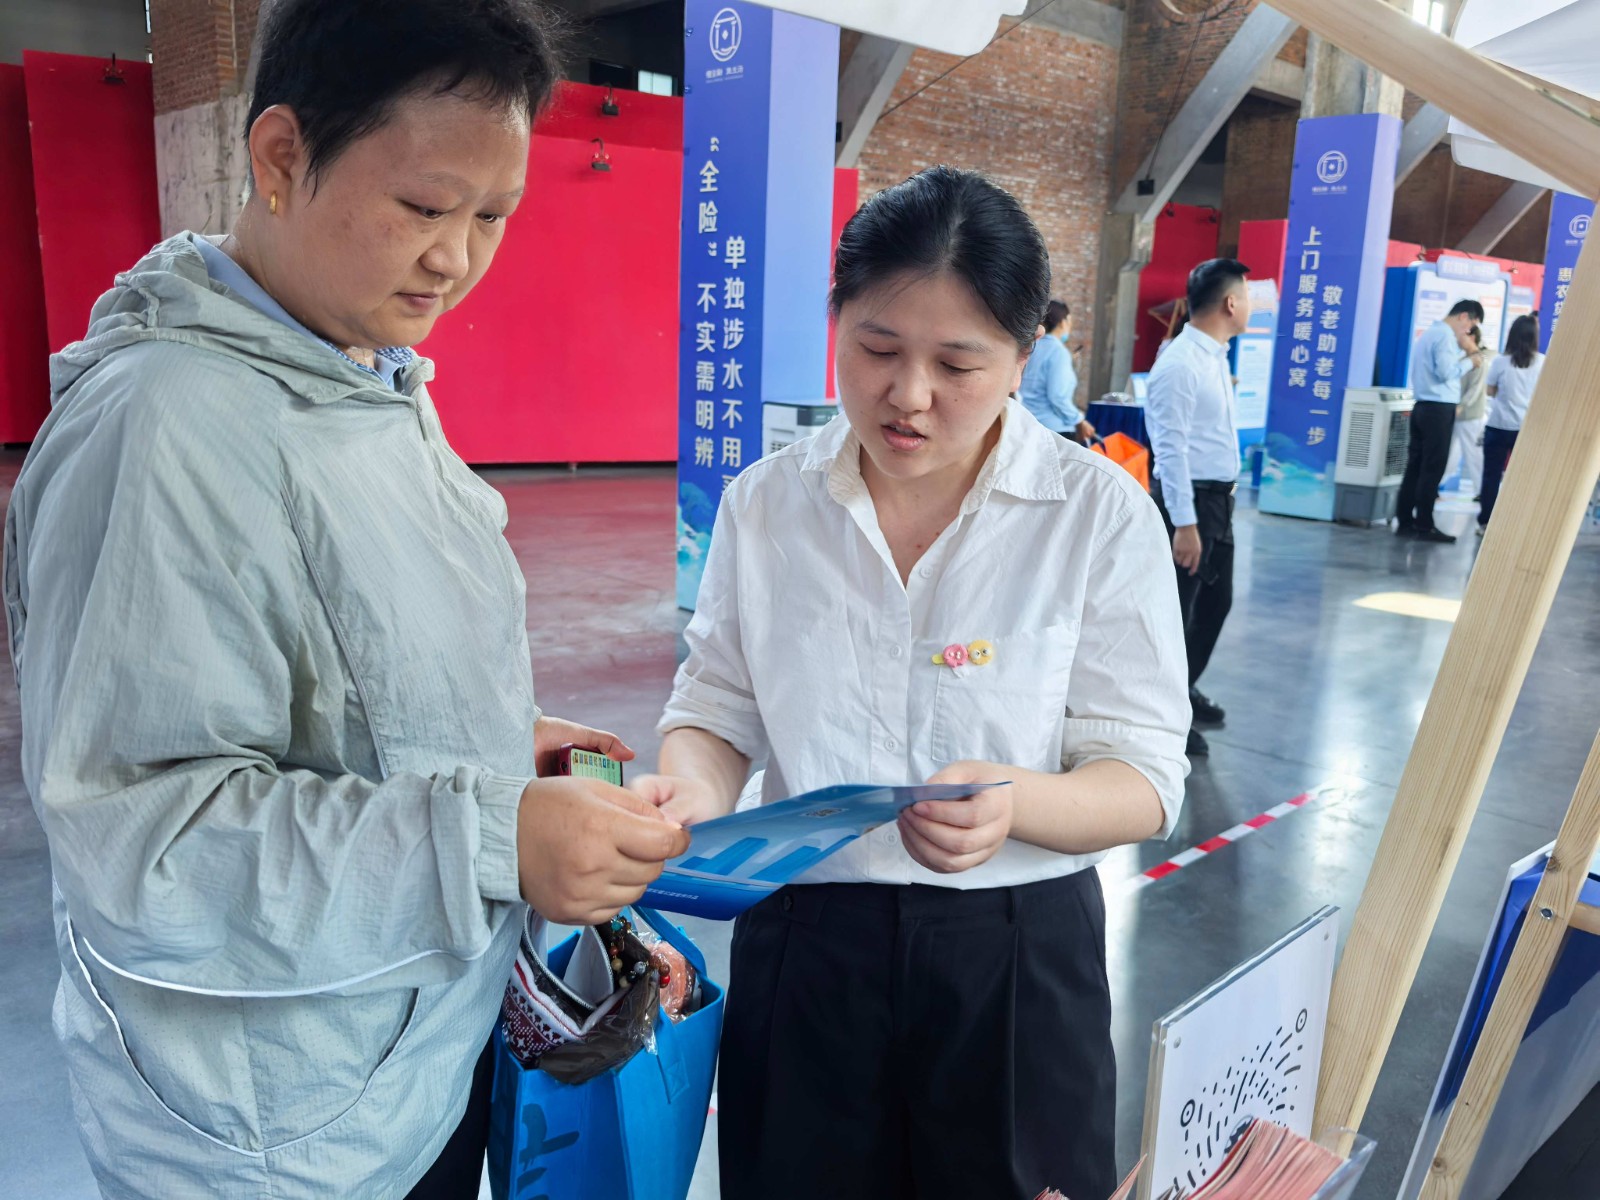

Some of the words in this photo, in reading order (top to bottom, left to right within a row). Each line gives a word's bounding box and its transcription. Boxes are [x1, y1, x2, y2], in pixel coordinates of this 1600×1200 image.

[1288, 225, 1322, 388] 上门服务暖心窝
[1306, 285, 1343, 447] 敬老助老每一步
